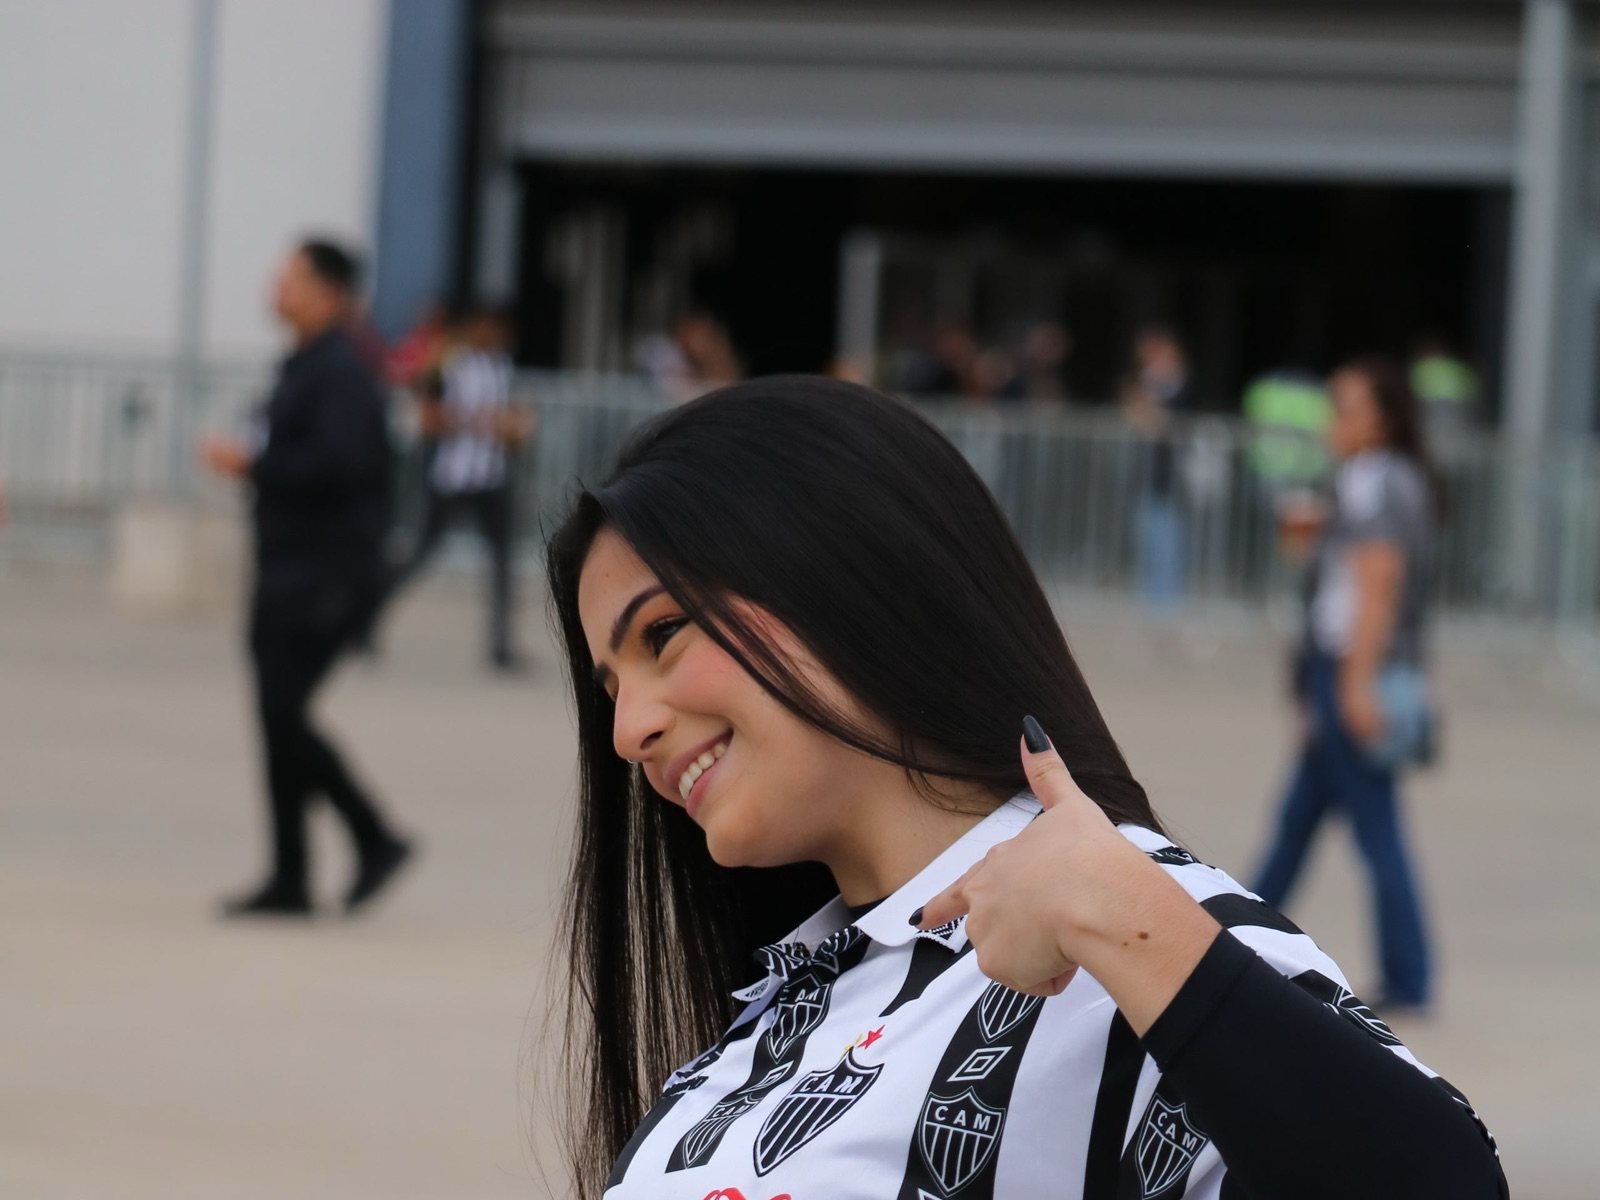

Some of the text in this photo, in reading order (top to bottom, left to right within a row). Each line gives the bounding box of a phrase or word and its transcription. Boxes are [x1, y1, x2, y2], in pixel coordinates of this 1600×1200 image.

[780, 988, 820, 1003] AM
[799, 1075, 863, 1093] CAM
[934, 1105, 991, 1132] CAM
[1157, 1111, 1198, 1152] CAM
